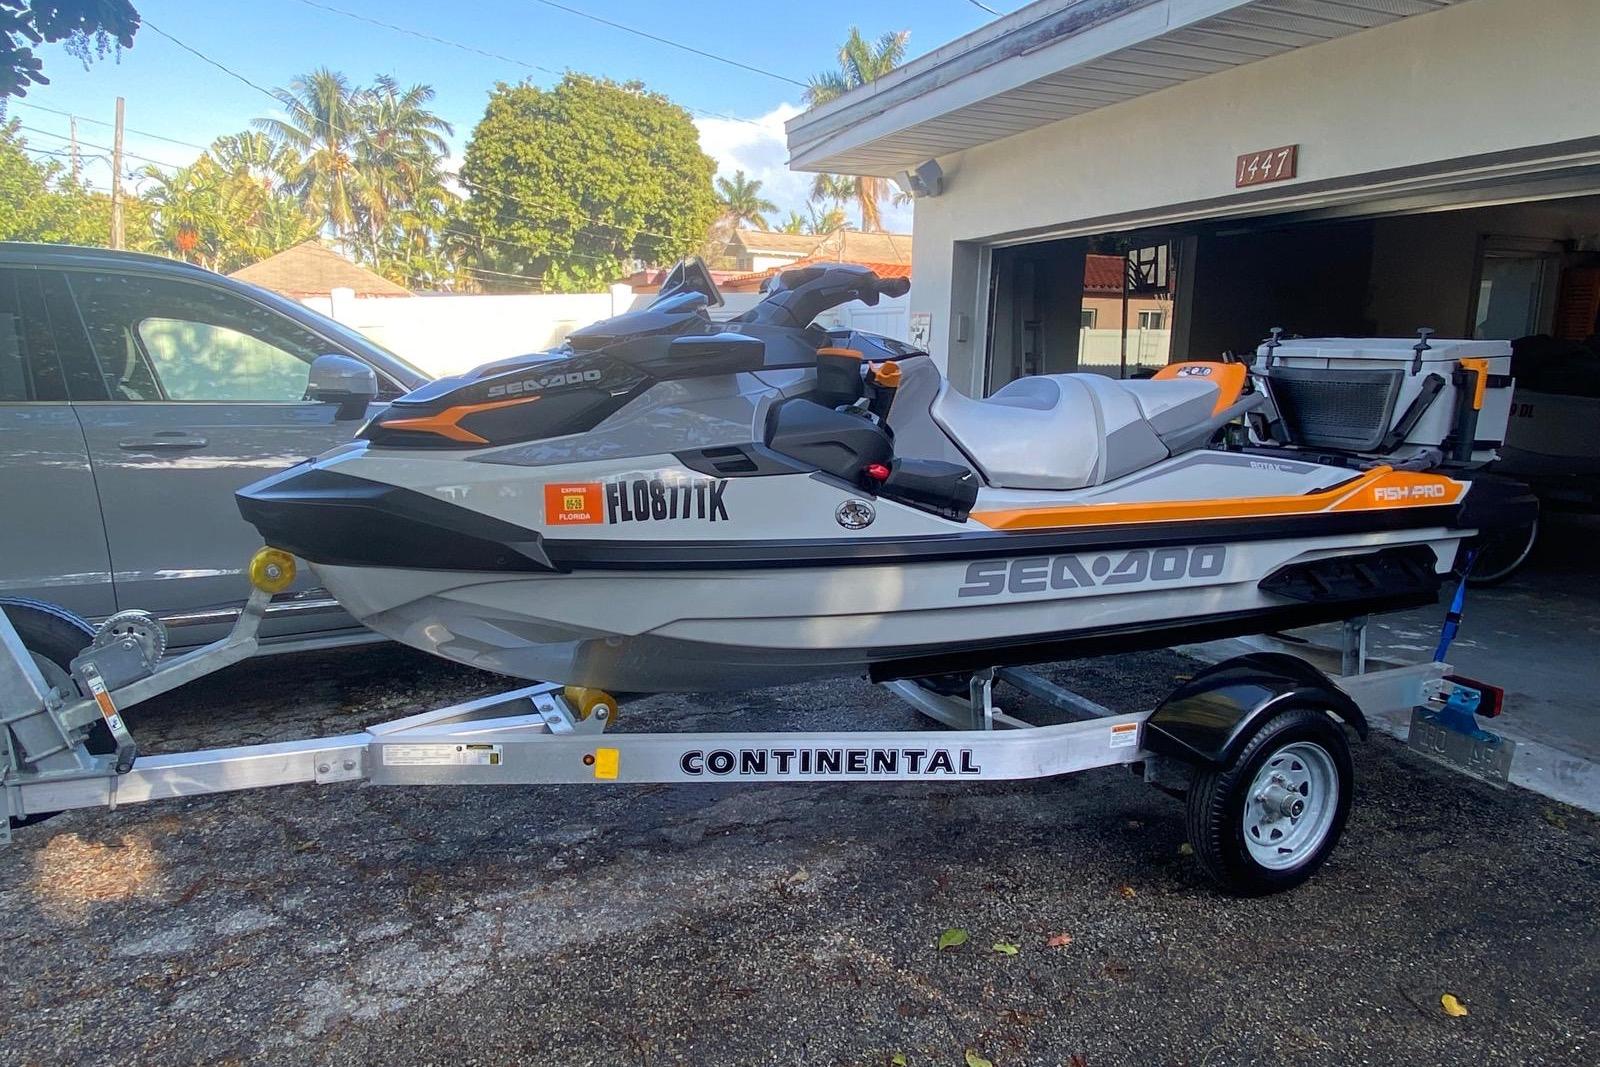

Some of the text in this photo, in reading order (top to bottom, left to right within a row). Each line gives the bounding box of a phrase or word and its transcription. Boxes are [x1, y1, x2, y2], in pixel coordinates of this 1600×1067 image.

[1239, 149, 1289, 182] 1447
[1412, 484, 1445, 498] PRO
[559, 513, 591, 521] FLORIDA
[680, 748, 981, 776] CONTINENTAL
